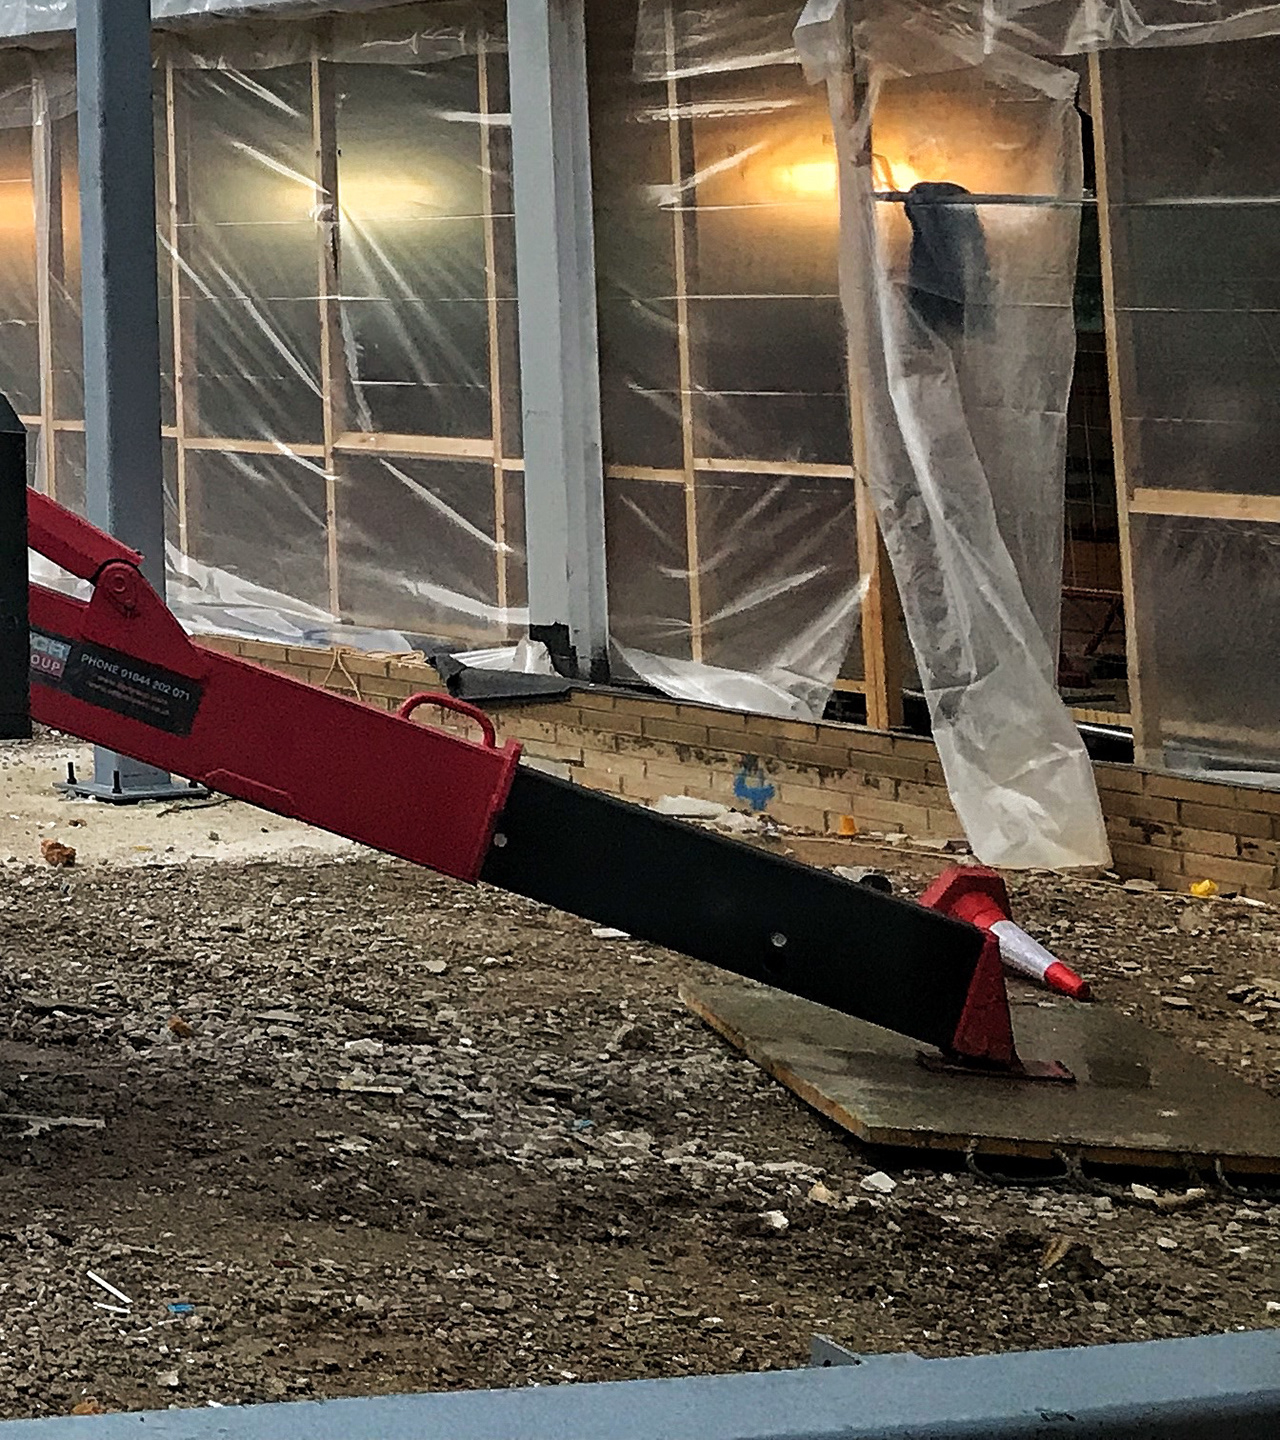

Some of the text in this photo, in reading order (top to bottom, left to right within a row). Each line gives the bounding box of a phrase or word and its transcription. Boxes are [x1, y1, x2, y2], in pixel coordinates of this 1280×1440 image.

[30, 633, 69, 659] GR
[30, 654, 61, 671] OUP
[81, 654, 119, 674] PHONE
[172, 687, 190, 700] 071
